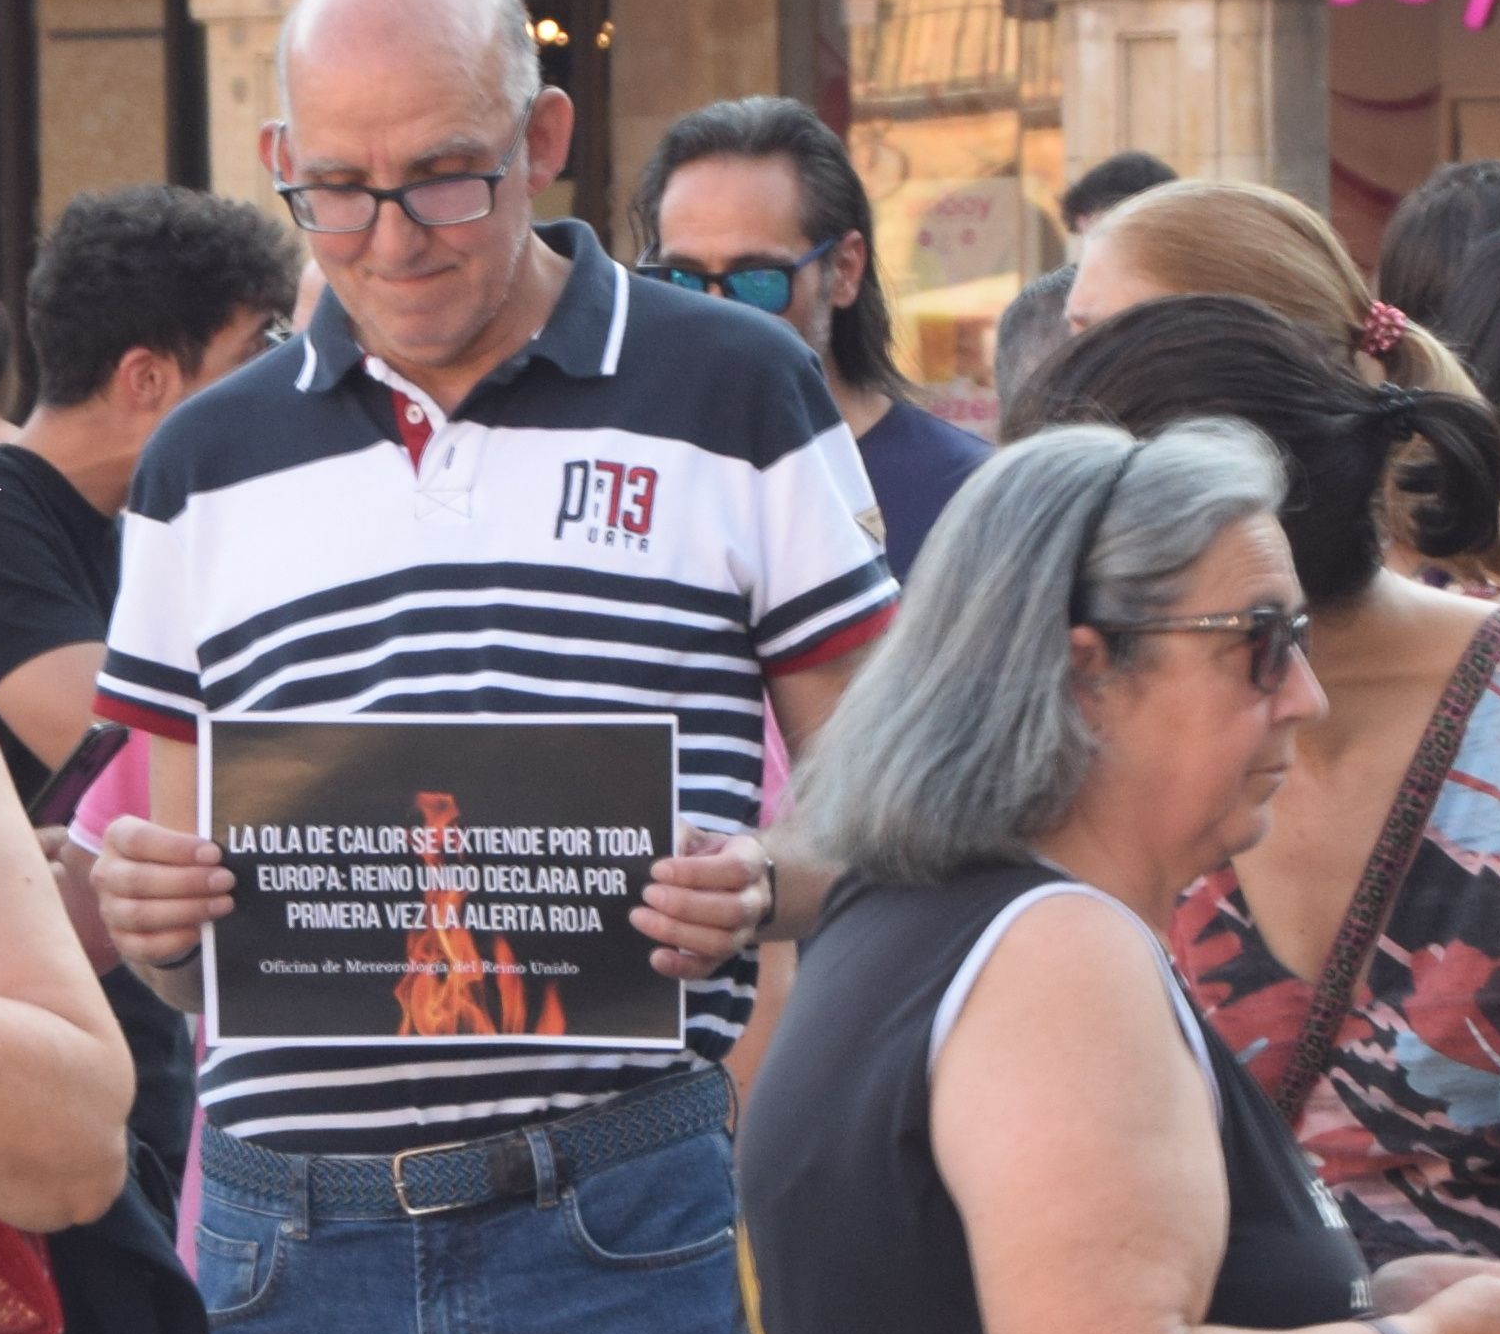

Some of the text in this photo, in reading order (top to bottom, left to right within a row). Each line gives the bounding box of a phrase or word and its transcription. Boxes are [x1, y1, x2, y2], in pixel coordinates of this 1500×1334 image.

[229, 825, 654, 857] LA OLA DE CALOR SE EXTIENDE POR TODA
[258, 864, 627, 896] EUROPA: REINO UNIDO DECLARA POR
[287, 902, 603, 933] PRIMERA VEZ LA ALERTA ROJA
[260, 959, 318, 974] Oficina
[322, 959, 341, 974] de
[453, 960, 477, 974] del
[481, 960, 526, 975] Reino
[531, 960, 579, 975] Unido
